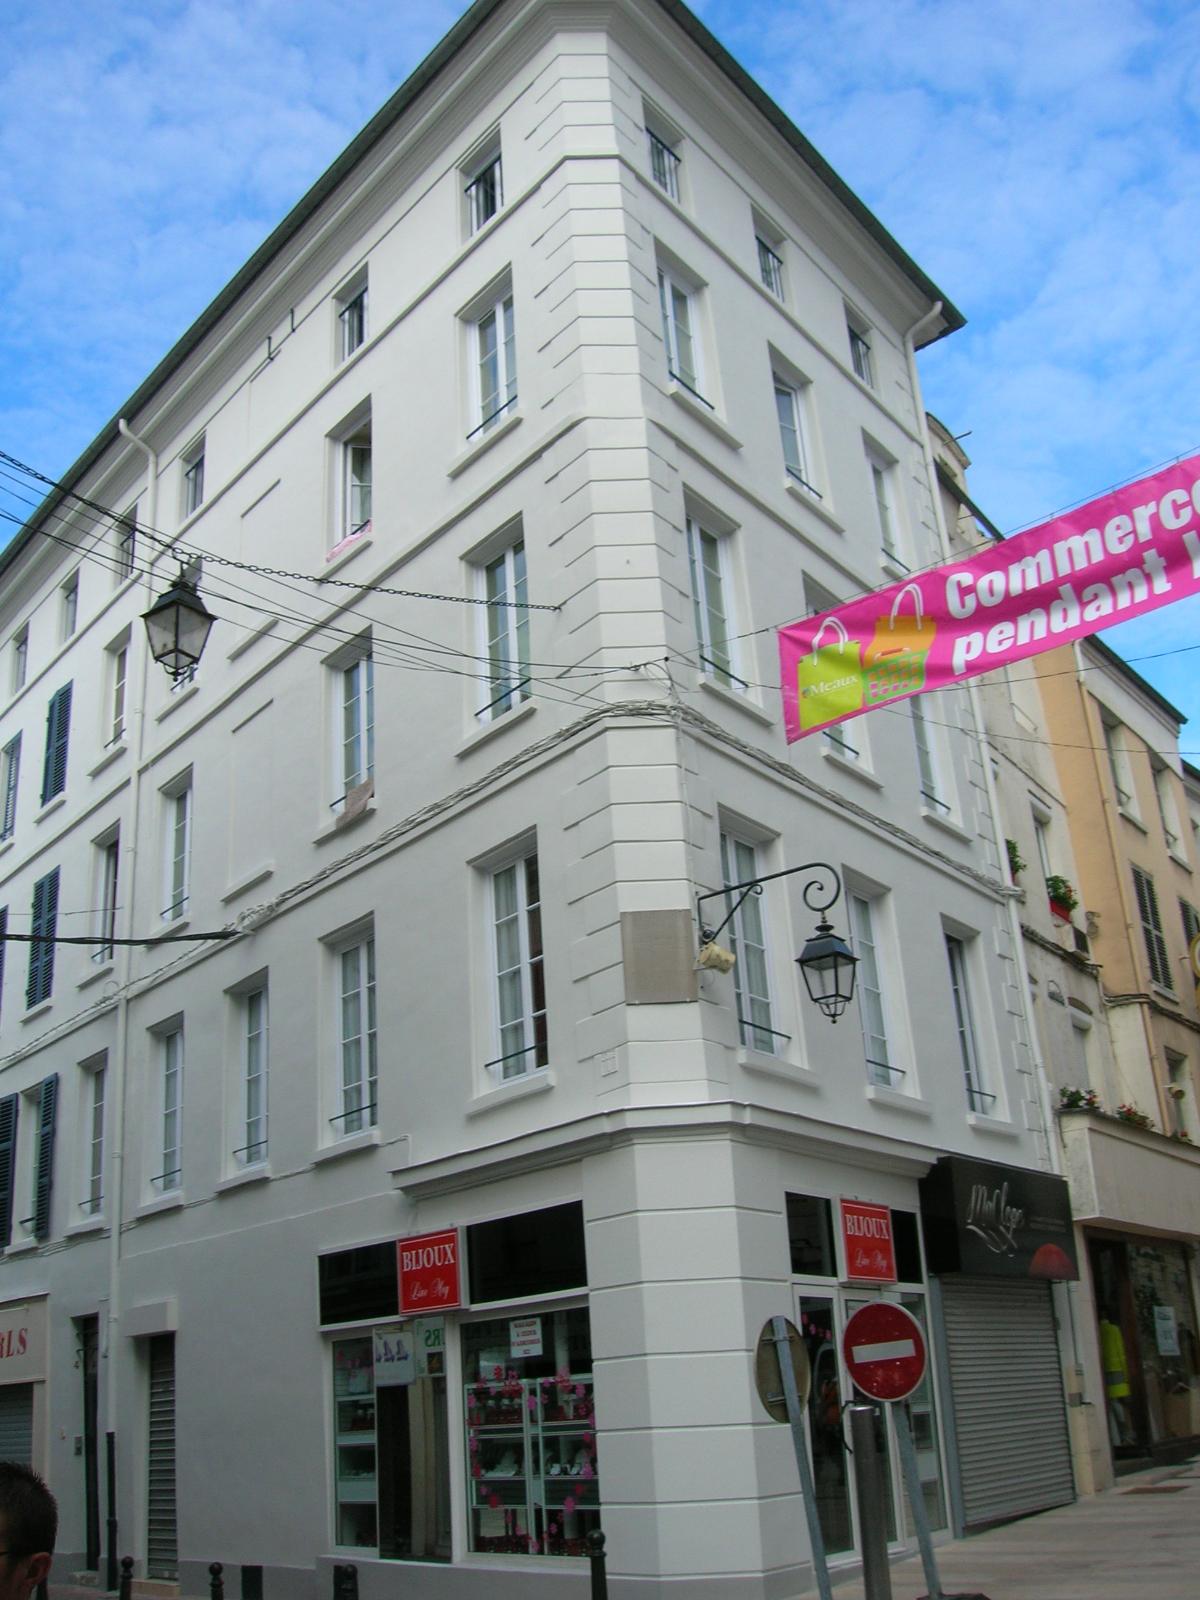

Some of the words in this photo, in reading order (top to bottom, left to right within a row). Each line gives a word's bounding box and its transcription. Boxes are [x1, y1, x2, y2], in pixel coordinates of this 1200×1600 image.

[945, 479, 1200, 619] Commerc
[952, 547, 1172, 676] pendant
[809, 675, 858, 697] Meaux
[845, 1214, 889, 1239] BIJOUX
[402, 1243, 456, 1272] BIJOUX
